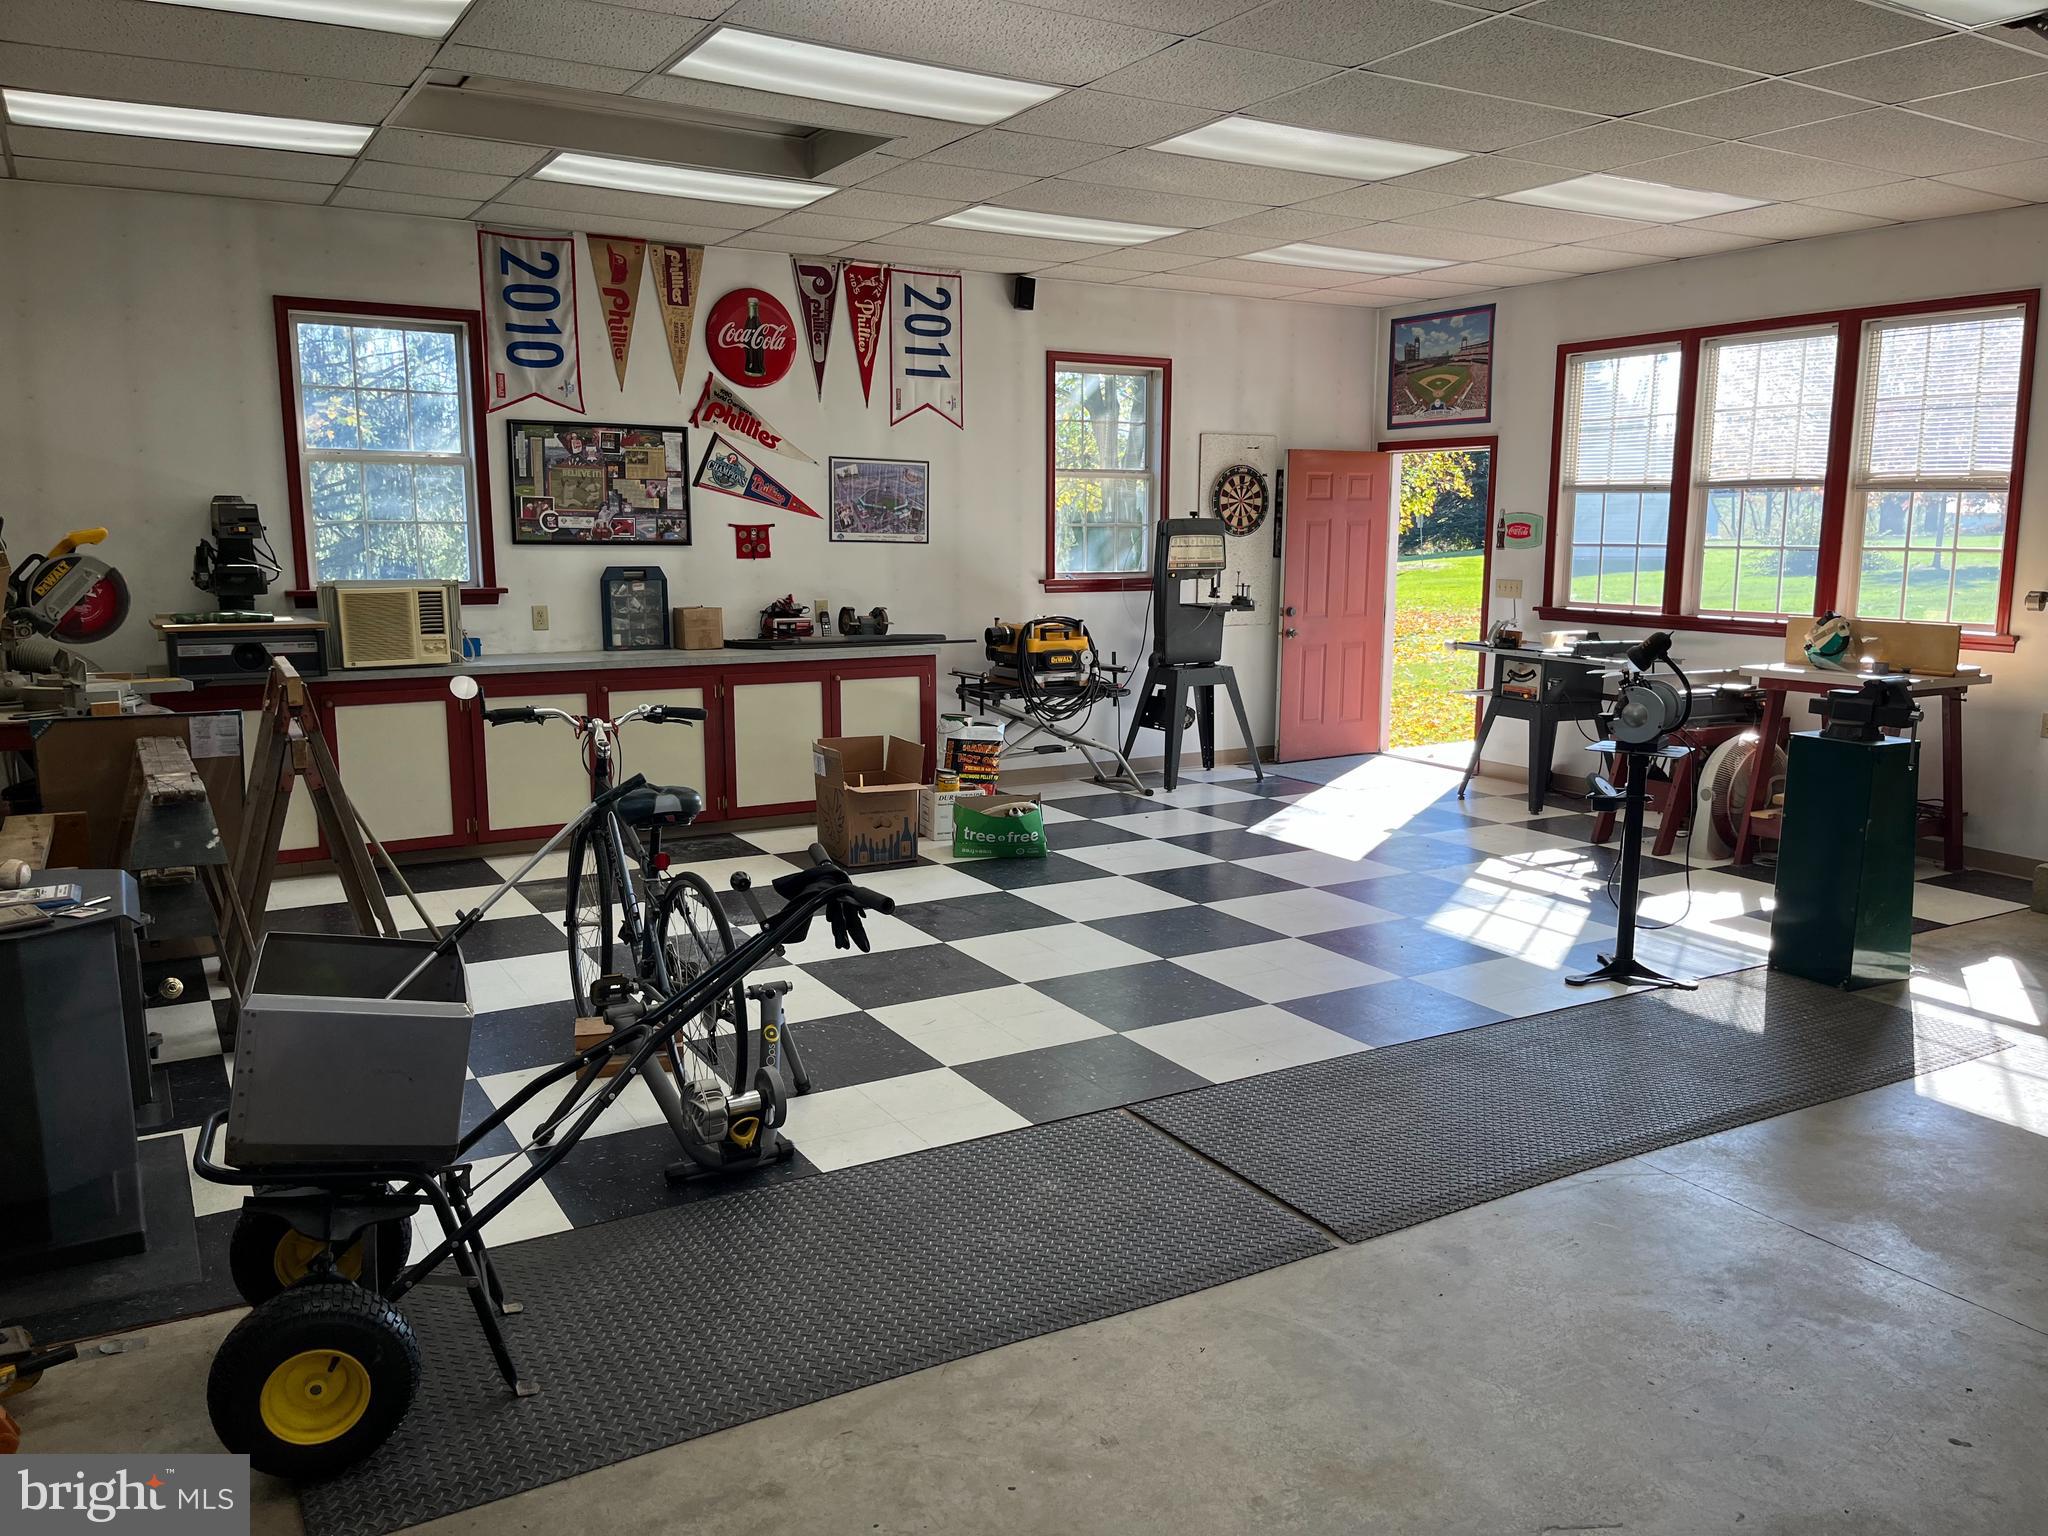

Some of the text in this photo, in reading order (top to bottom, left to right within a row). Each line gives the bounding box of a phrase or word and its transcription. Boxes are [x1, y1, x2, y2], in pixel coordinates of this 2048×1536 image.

[849, 273, 861, 295] KIDS
[500, 247, 564, 368] 2010
[718, 321, 788, 351] Coca-Cola
[855, 299, 876, 353] Phillies
[904, 283, 952, 378] 2011
[562, 468, 591, 477] BELIEVE
[707, 459, 749, 488] CHAMPIONS
[752, 474, 785, 502] Phillies
[1508, 525, 1529, 536] Coca-Cola
[958, 753, 980, 765] HOT
[964, 827, 1039, 843] tree free
